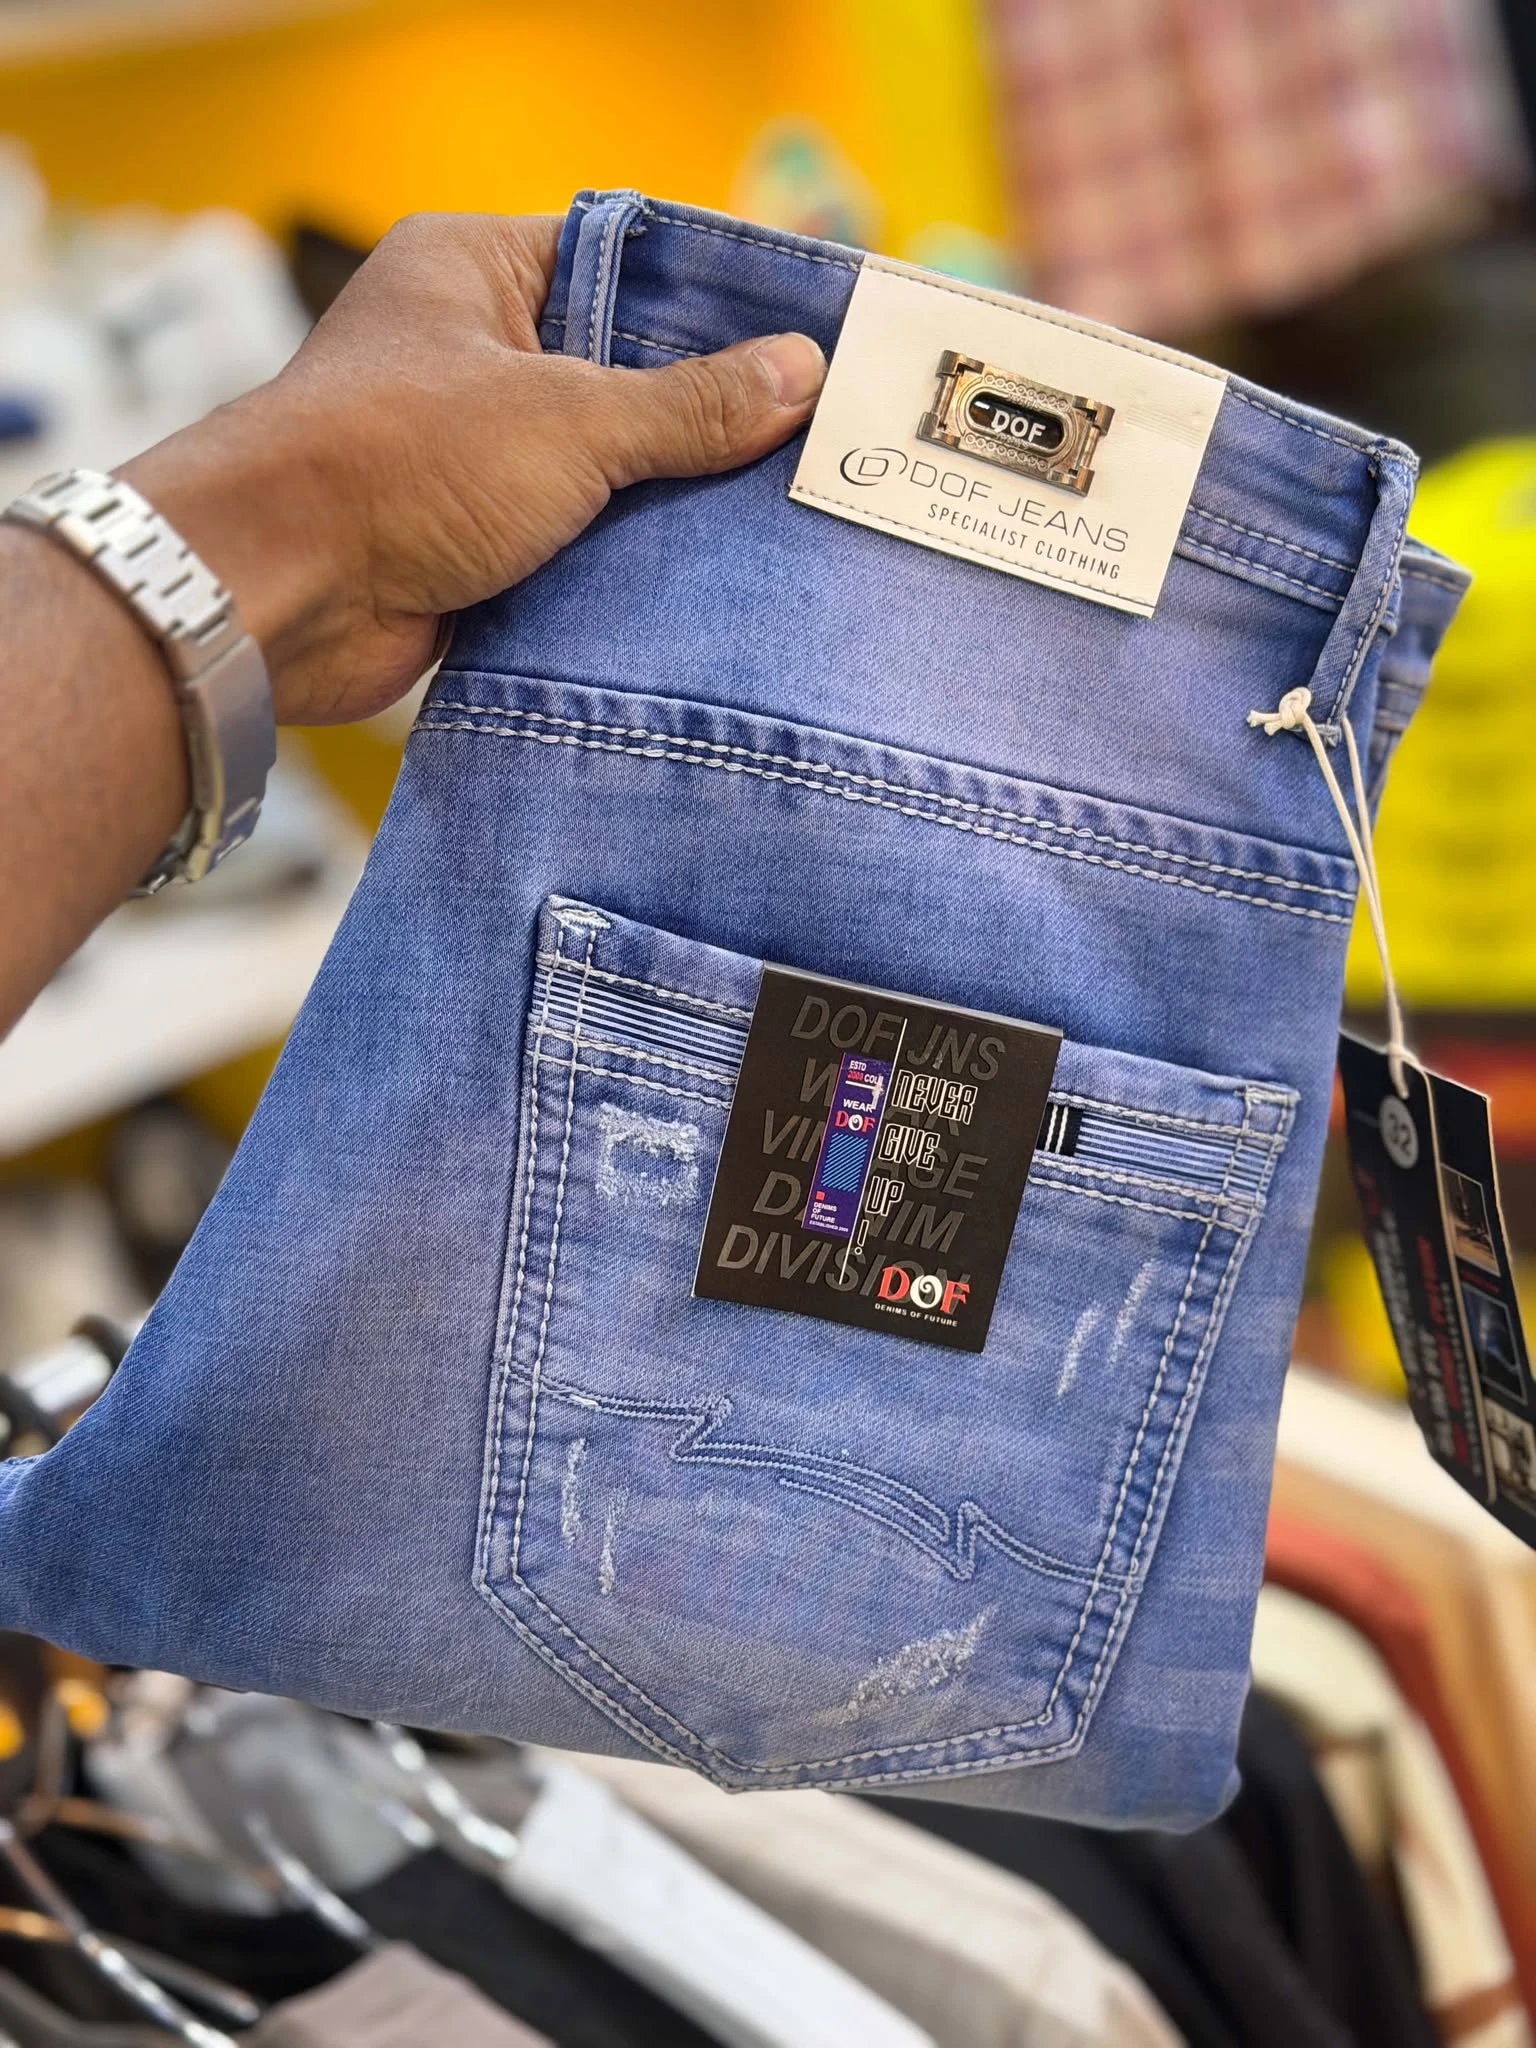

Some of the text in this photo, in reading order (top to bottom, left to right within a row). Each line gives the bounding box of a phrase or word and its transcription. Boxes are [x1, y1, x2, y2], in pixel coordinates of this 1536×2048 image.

[991, 408, 1046, 442] DOF
[909, 460, 993, 502] DOF
[998, 497, 1129, 553] JEANS
[928, 503, 1121, 580] SPECIALIST CLOTHING
[790, 995, 1006, 1082] DOF JNS
[849, 1060, 867, 1072] ESTD
[843, 1098, 874, 1113] WEAR
[891, 1070, 978, 1126] NEVER
[834, 1110, 876, 1133] DOF
[878, 1123, 941, 1171] GIVE
[865, 1175, 905, 1217] UP
[811, 1213, 836, 1224] FUTURE
[877, 1266, 970, 1315] DOF
[874, 1303, 958, 1327] DENIMS OF FUTURE
